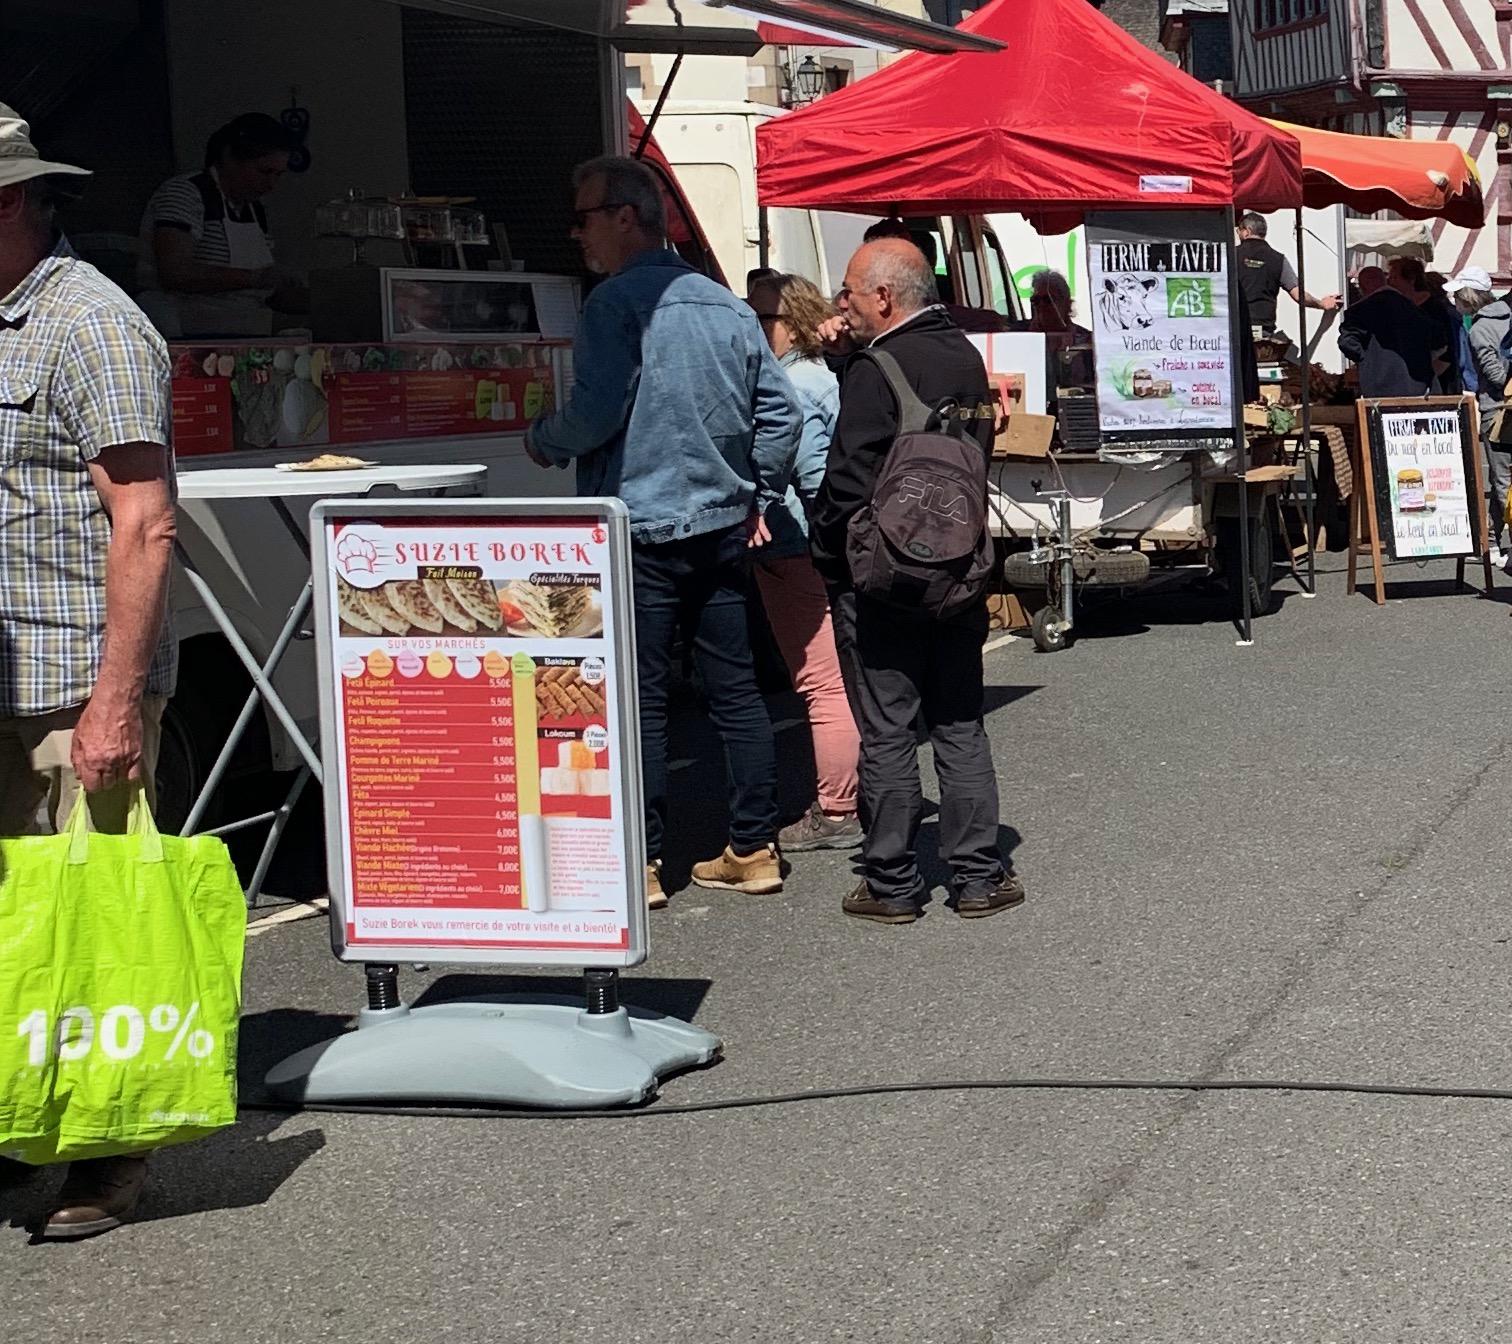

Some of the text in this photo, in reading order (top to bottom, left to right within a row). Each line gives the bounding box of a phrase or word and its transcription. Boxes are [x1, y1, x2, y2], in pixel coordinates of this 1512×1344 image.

[1103, 243, 1151, 272] FERME
[1171, 242, 1220, 272] FAVET
[1170, 289, 1205, 316] AB
[1122, 335, 1163, 351] Viande
[1170, 335, 1184, 351] de
[898, 476, 968, 524] FILA
[395, 542, 593, 566] SUZIE BOREK
[425, 567, 445, 578] Fait
[387, 637, 486, 649] SUR VOS MARCHÉS
[544, 658, 575, 666] Baklava
[489, 678, 511, 688] 5,50€
[490, 697, 512, 706] 5,50€
[491, 716, 513, 726] 5,50€
[544, 729, 575, 737] Lokoum
[492, 736, 514, 746] 5,50€
[350, 755, 379, 765] Pomme
[380, 756, 390, 765] de
[391, 755, 411, 765] Terre
[493, 756, 515, 766] 5,50€
[362, 917, 388, 929] Suzie
[391, 918, 418, 929] Borek
[421, 921, 444, 929] vous
[446, 919, 490, 930] remercie
[492, 919, 503, 931] de
[505, 921, 531, 931] votre
[534, 920, 560, 932] visite
[562, 922, 572, 932] et
[17, 1002, 215, 1067] 100%
